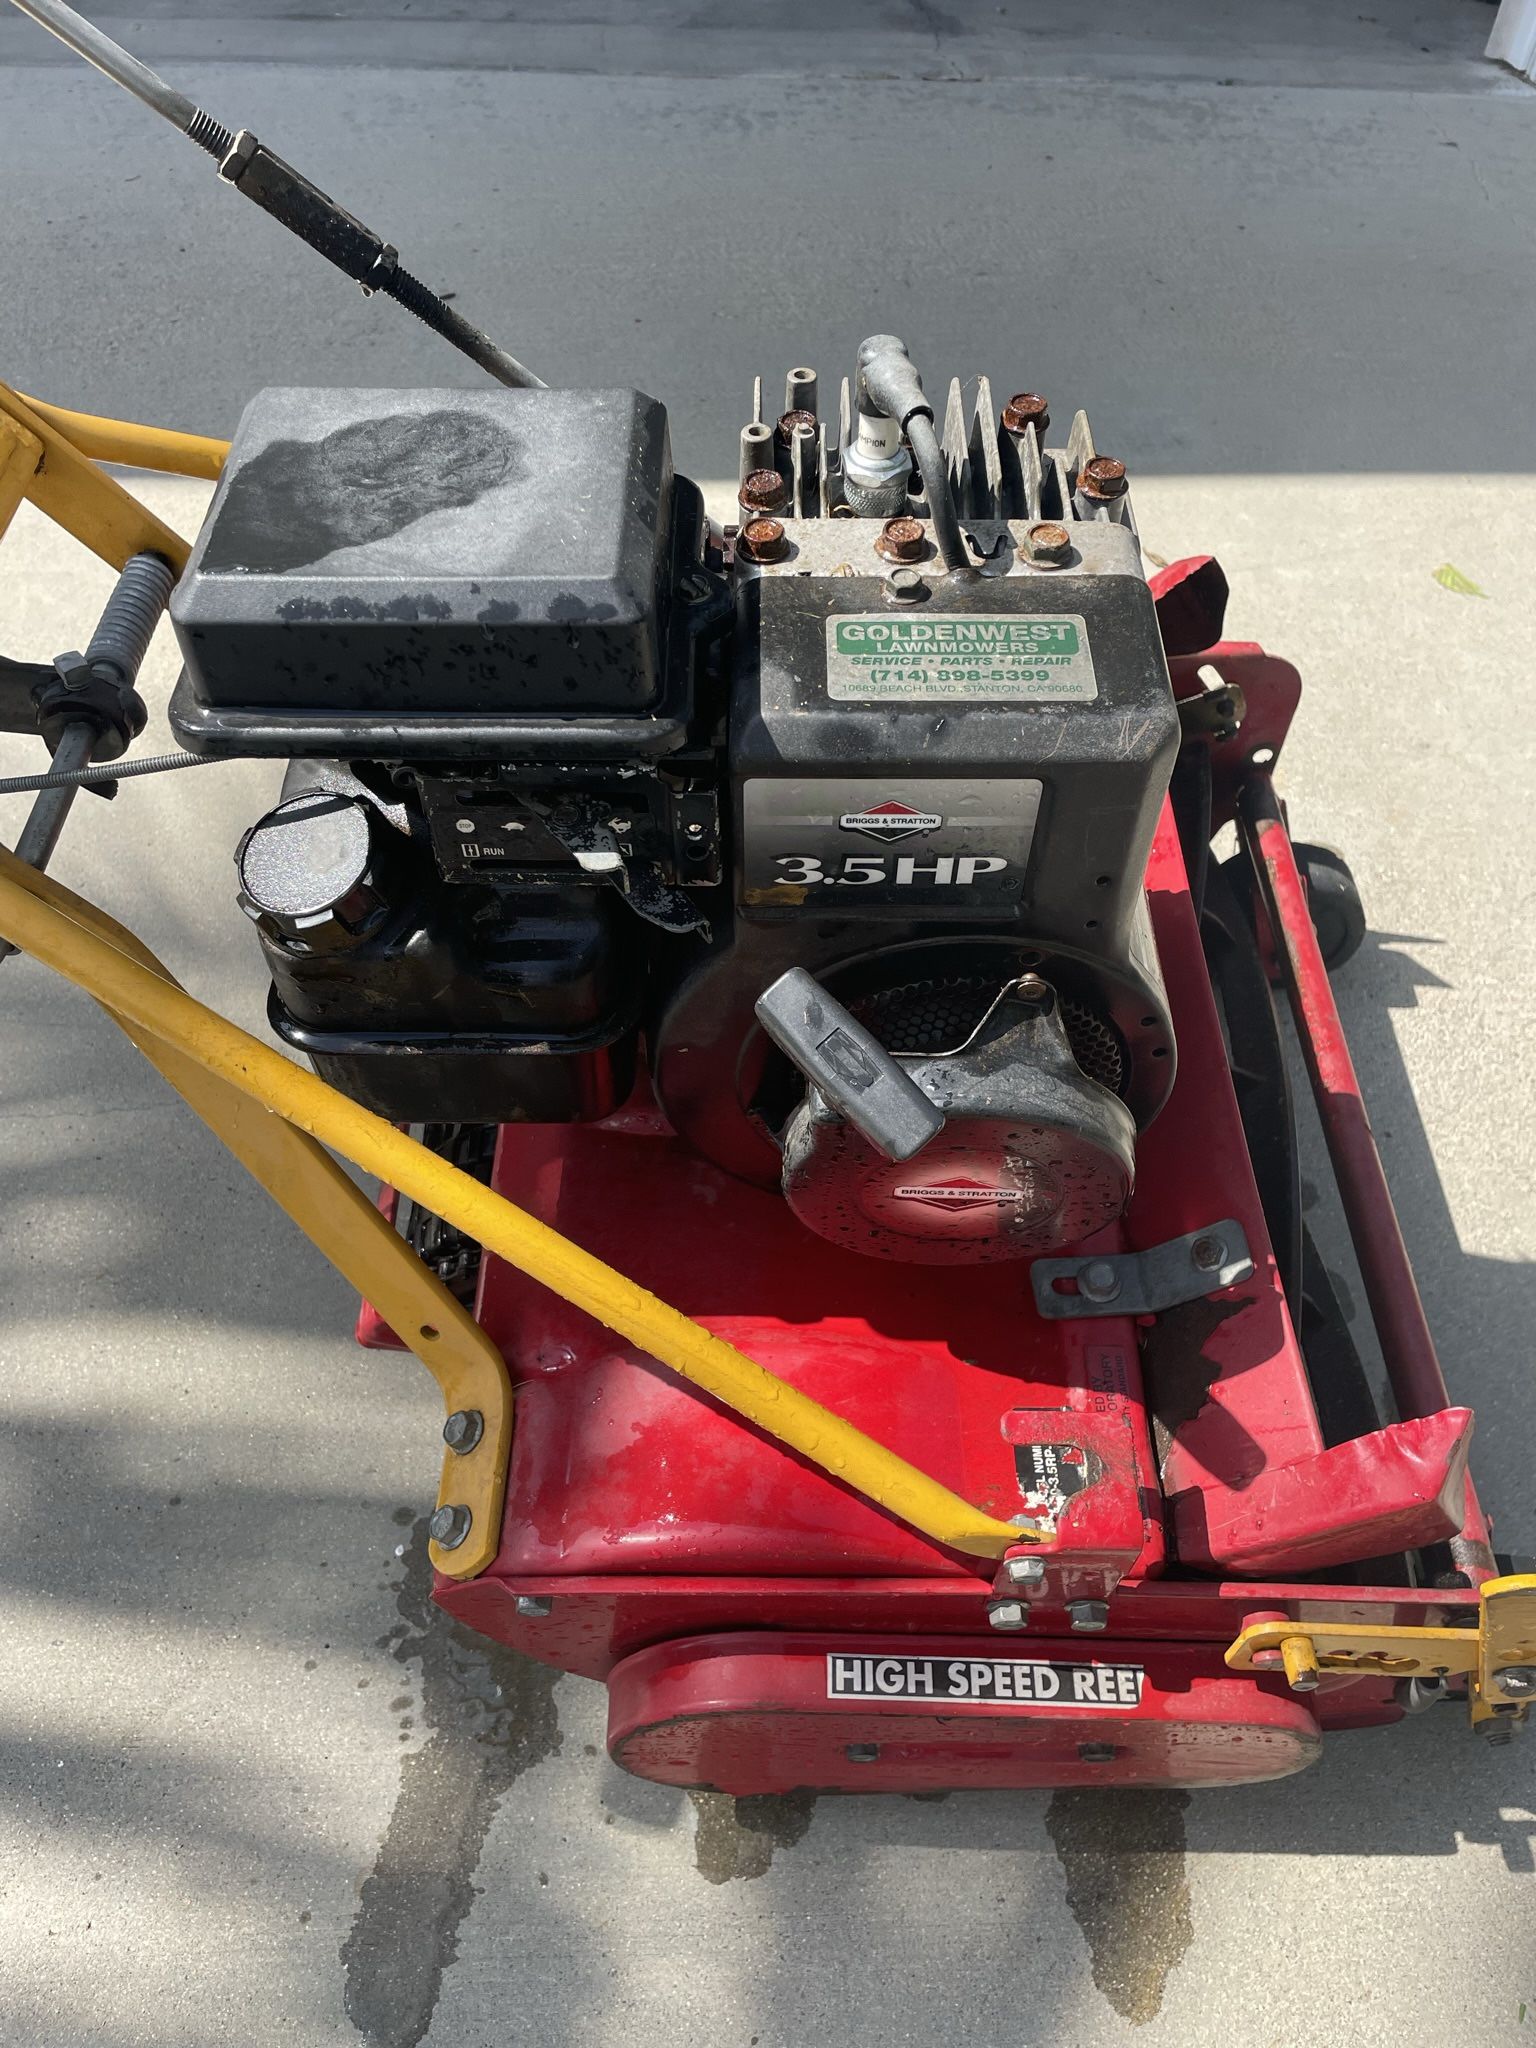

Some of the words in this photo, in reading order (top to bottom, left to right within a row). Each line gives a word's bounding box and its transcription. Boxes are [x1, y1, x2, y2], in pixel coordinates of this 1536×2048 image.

[842, 624, 1071, 641] GOLDENWEST
[876, 641, 1039, 653] LAWNMOWERS
[851, 656, 922, 666] SERVICE
[940, 656, 993, 666] PARTS
[1011, 656, 1072, 666] REPAIR
[870, 669, 929, 683] (714)
[936, 669, 1050, 682] 898-5399
[842, 684, 876, 693] 10689
[879, 684, 922, 693] BEACH
[1027, 684, 1046, 693] CA
[1046, 684, 1083, 693] 90680
[845, 817, 880, 825] BRIGGS
[882, 817, 889, 825] &
[890, 818, 936, 826] STRATTON
[483, 847, 505, 856] RUN
[958, 1190, 1017, 1198] STRATTON
[1102, 1352, 1118, 1411] ORATORY
[835, 1658, 934, 1695] HIGH
[947, 1662, 1061, 1699] SPEED
